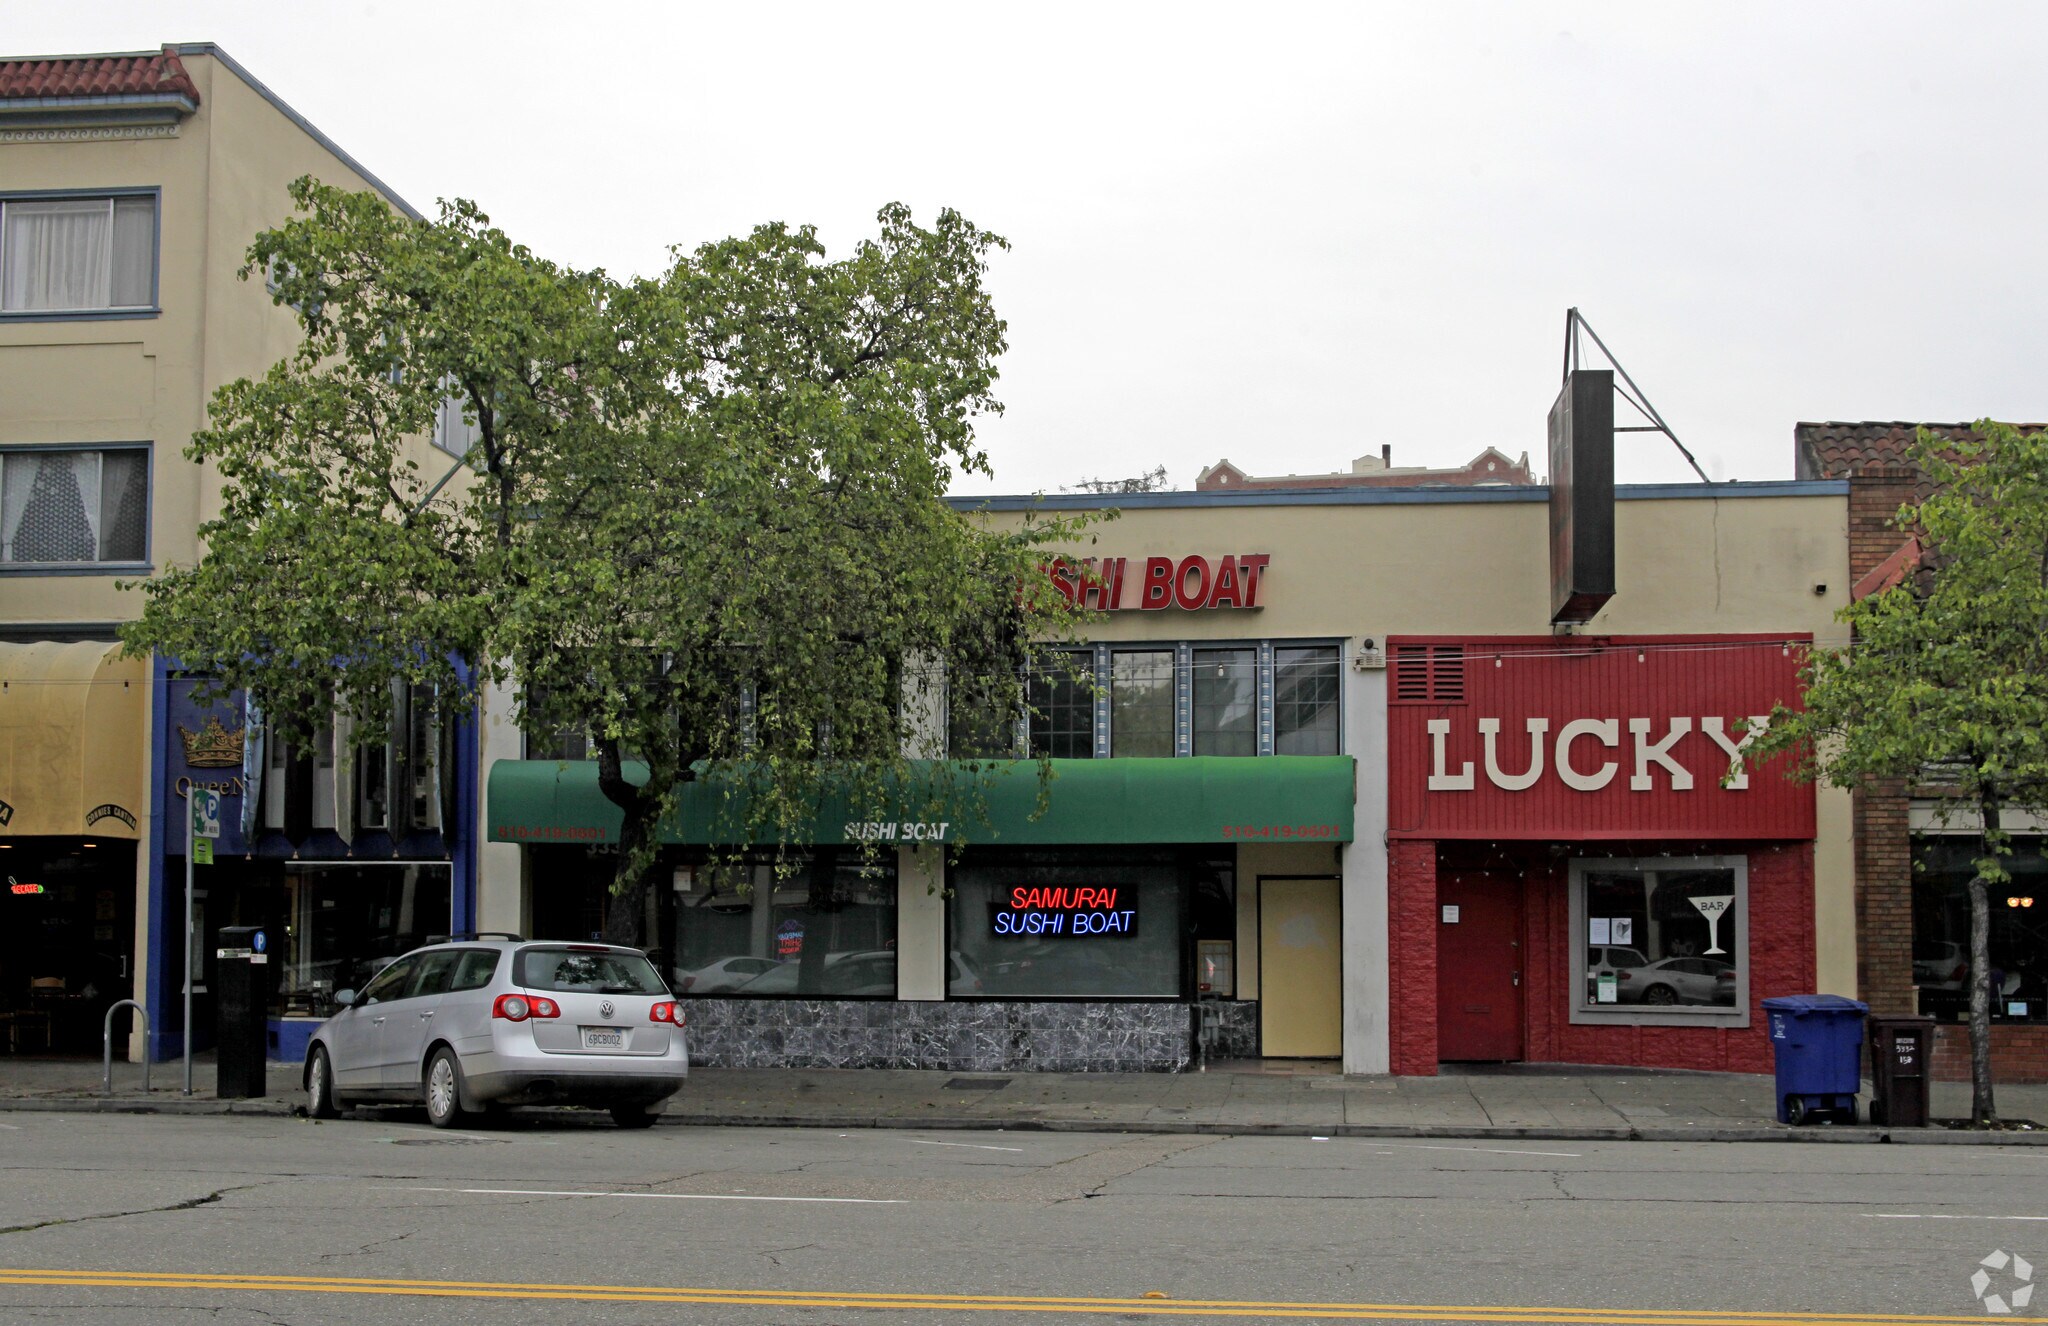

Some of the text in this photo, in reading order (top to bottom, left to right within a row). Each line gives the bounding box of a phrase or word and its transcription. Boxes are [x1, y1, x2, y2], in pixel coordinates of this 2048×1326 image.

[1014, 553, 1271, 612] SHI BOAT
[1427, 715, 1770, 791] LUCKY
[844, 822, 897, 841] SUSHI
[1222, 824, 1340, 839] 510-419-0601
[1010, 887, 1117, 909] SAMURAI
[1700, 901, 1725, 911] BAR
[994, 910, 1136, 934] SUSHI BOAT
